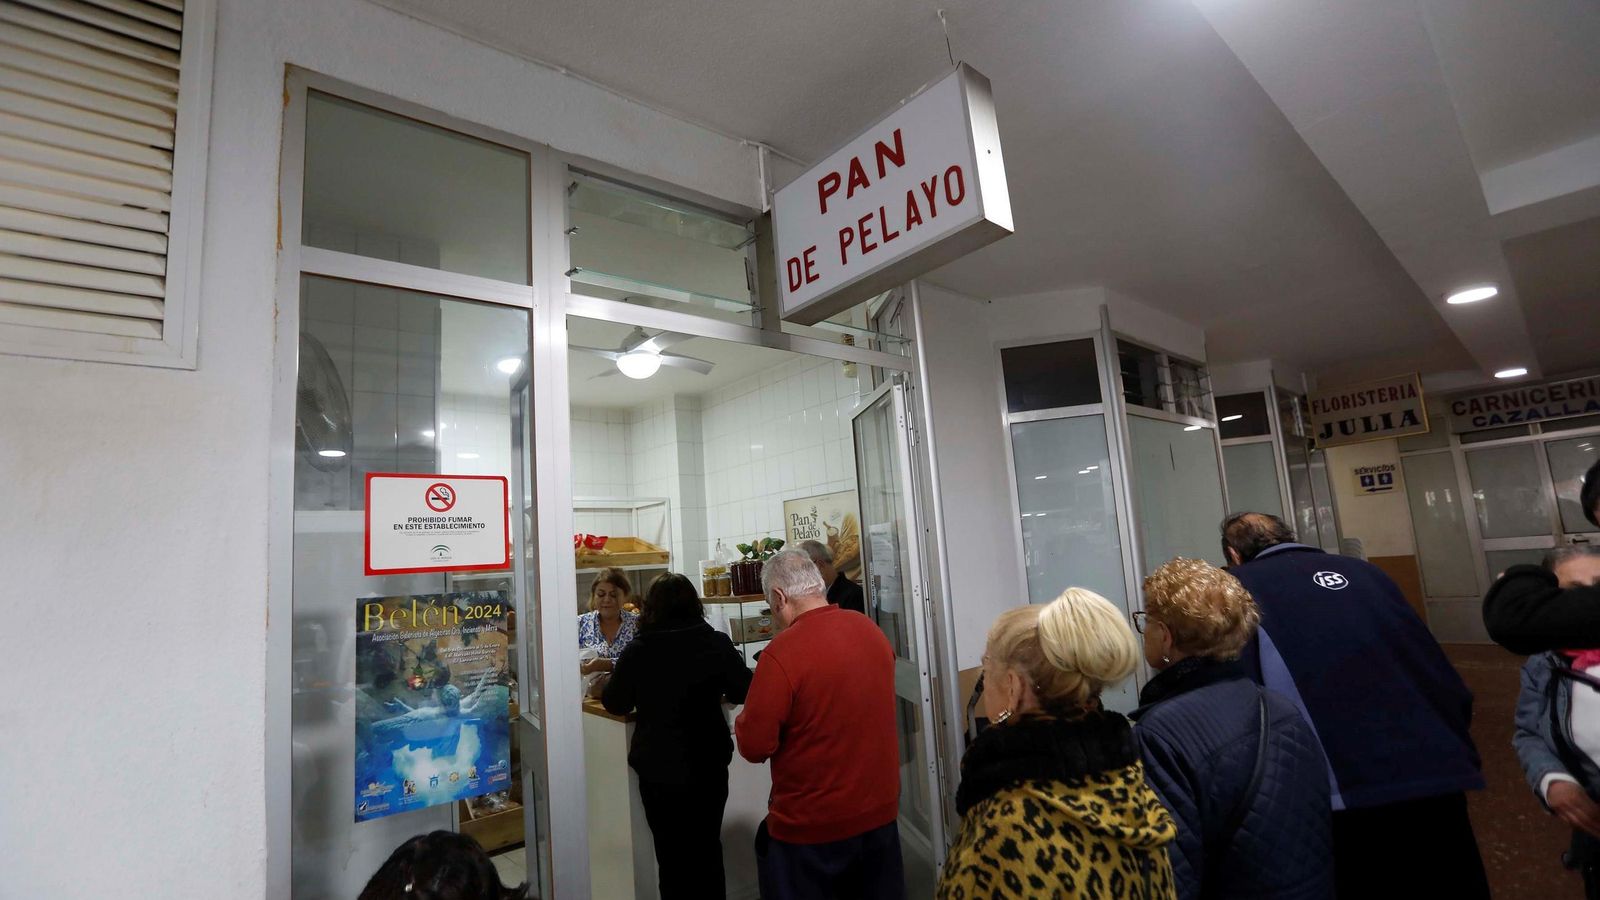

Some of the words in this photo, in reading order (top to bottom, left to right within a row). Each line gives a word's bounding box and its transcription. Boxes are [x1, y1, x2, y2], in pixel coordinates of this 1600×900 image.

[817, 127, 906, 215] PAN
[786, 245, 820, 293] DE
[839, 164, 966, 266] PELAYO
[1312, 383, 1417, 415] FLORISTERIA
[1451, 379, 1600, 416] CARNICERI
[1472, 399, 1600, 427] CAZALLA
[1318, 409, 1421, 440] JULIA
[424, 522, 486, 530] ESTABLECIMIENTO
[790, 513, 810, 527] Pan
[792, 526, 821, 540] Pelayo
[364, 598, 460, 632] Belén
[464, 604, 502, 620] 2024
